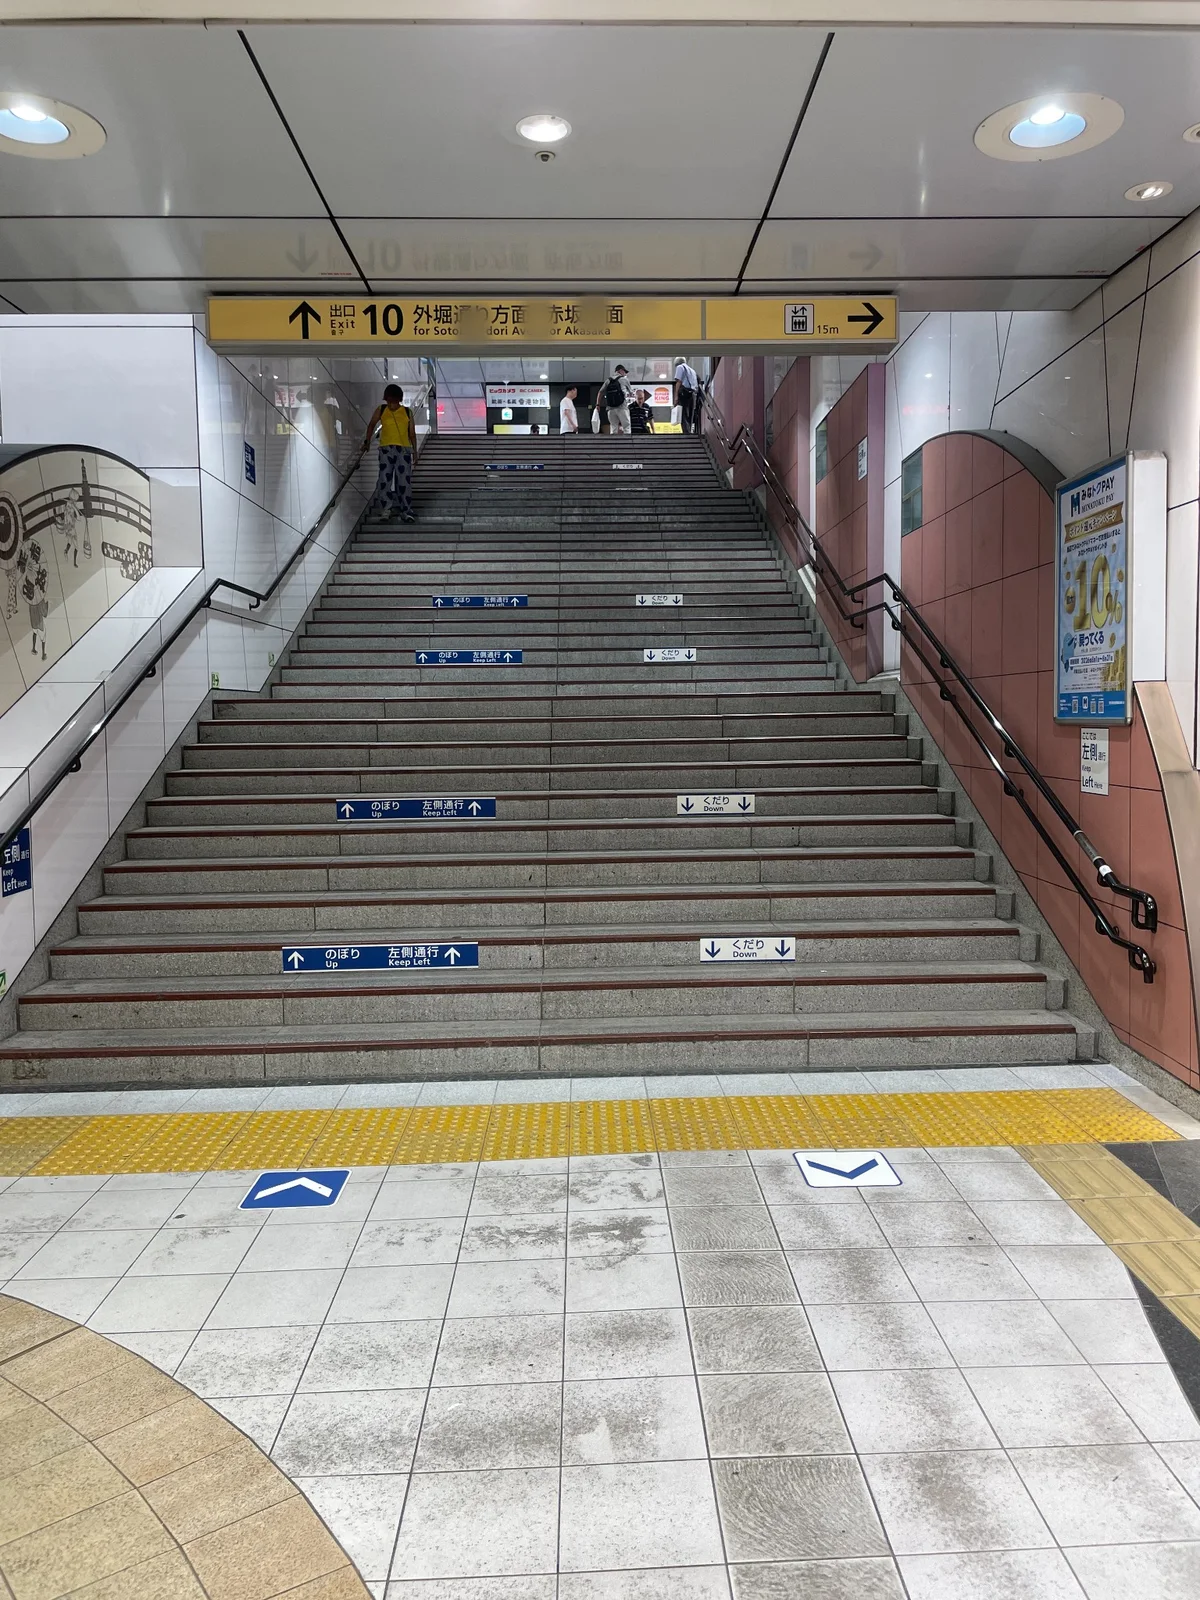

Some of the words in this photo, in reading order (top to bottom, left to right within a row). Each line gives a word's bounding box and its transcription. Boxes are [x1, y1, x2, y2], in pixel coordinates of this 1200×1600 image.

[330, 304, 355, 318] 出口
[547, 304, 624, 324] 赤坂面
[330, 319, 355, 328] Exit
[362, 304, 404, 336] 10
[414, 325, 430, 336] for
[817, 325, 839, 334] 15m
[1074, 553, 1122, 632] 10%
[1079, 631, 1104, 647] 戻ってくる
[1082, 732, 1096, 740] ここでは
[1082, 765, 1092, 773] Keep
[1082, 776, 1094, 788] Left
[371, 801, 400, 810] のぼり
[422, 800, 464, 810] 左側通行
[704, 796, 730, 805] くだり
[3, 868, 14, 876] Keep
[3, 878, 17, 892] Left
[18, 880, 28, 888] Here
[732, 938, 764, 950] くだり
[325, 948, 360, 960] のぼり
[388, 946, 439, 958] 左側通行
[326, 960, 338, 968] Up
[413, 958, 430, 966] Left
